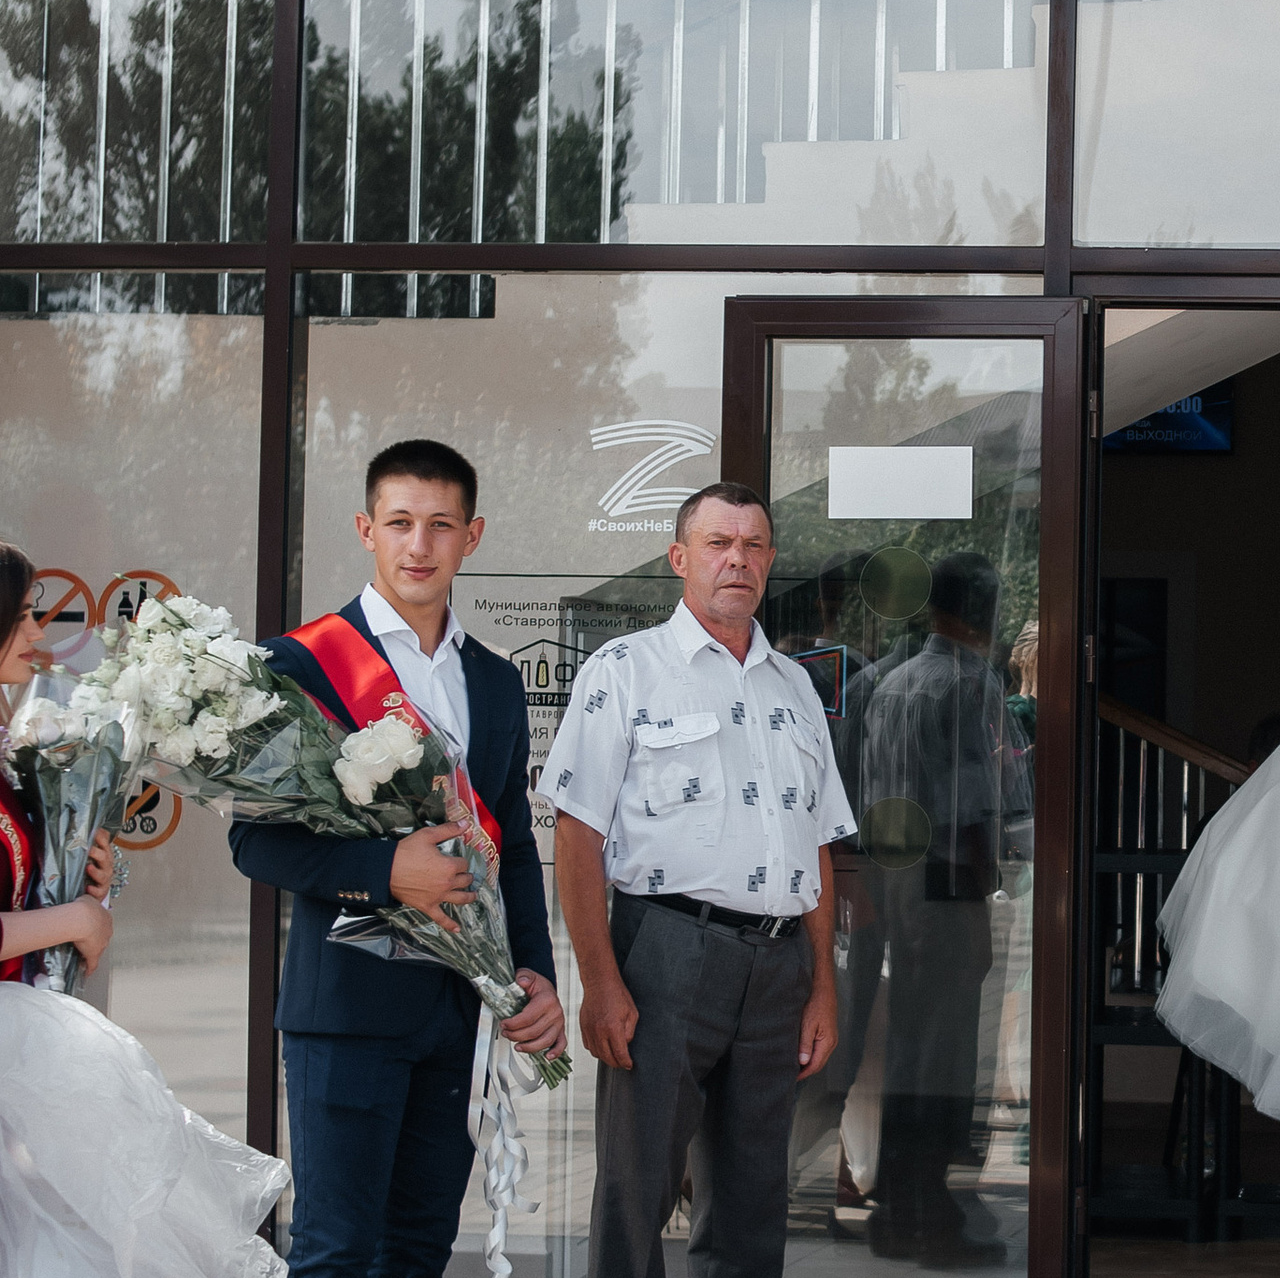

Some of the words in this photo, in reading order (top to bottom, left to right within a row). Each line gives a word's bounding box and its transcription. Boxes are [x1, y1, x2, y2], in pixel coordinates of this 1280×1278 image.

[588, 518, 676, 534] #СвоихНеБ
[474, 599, 591, 613] Муниципальное
[597, 603, 675, 613] автономно
